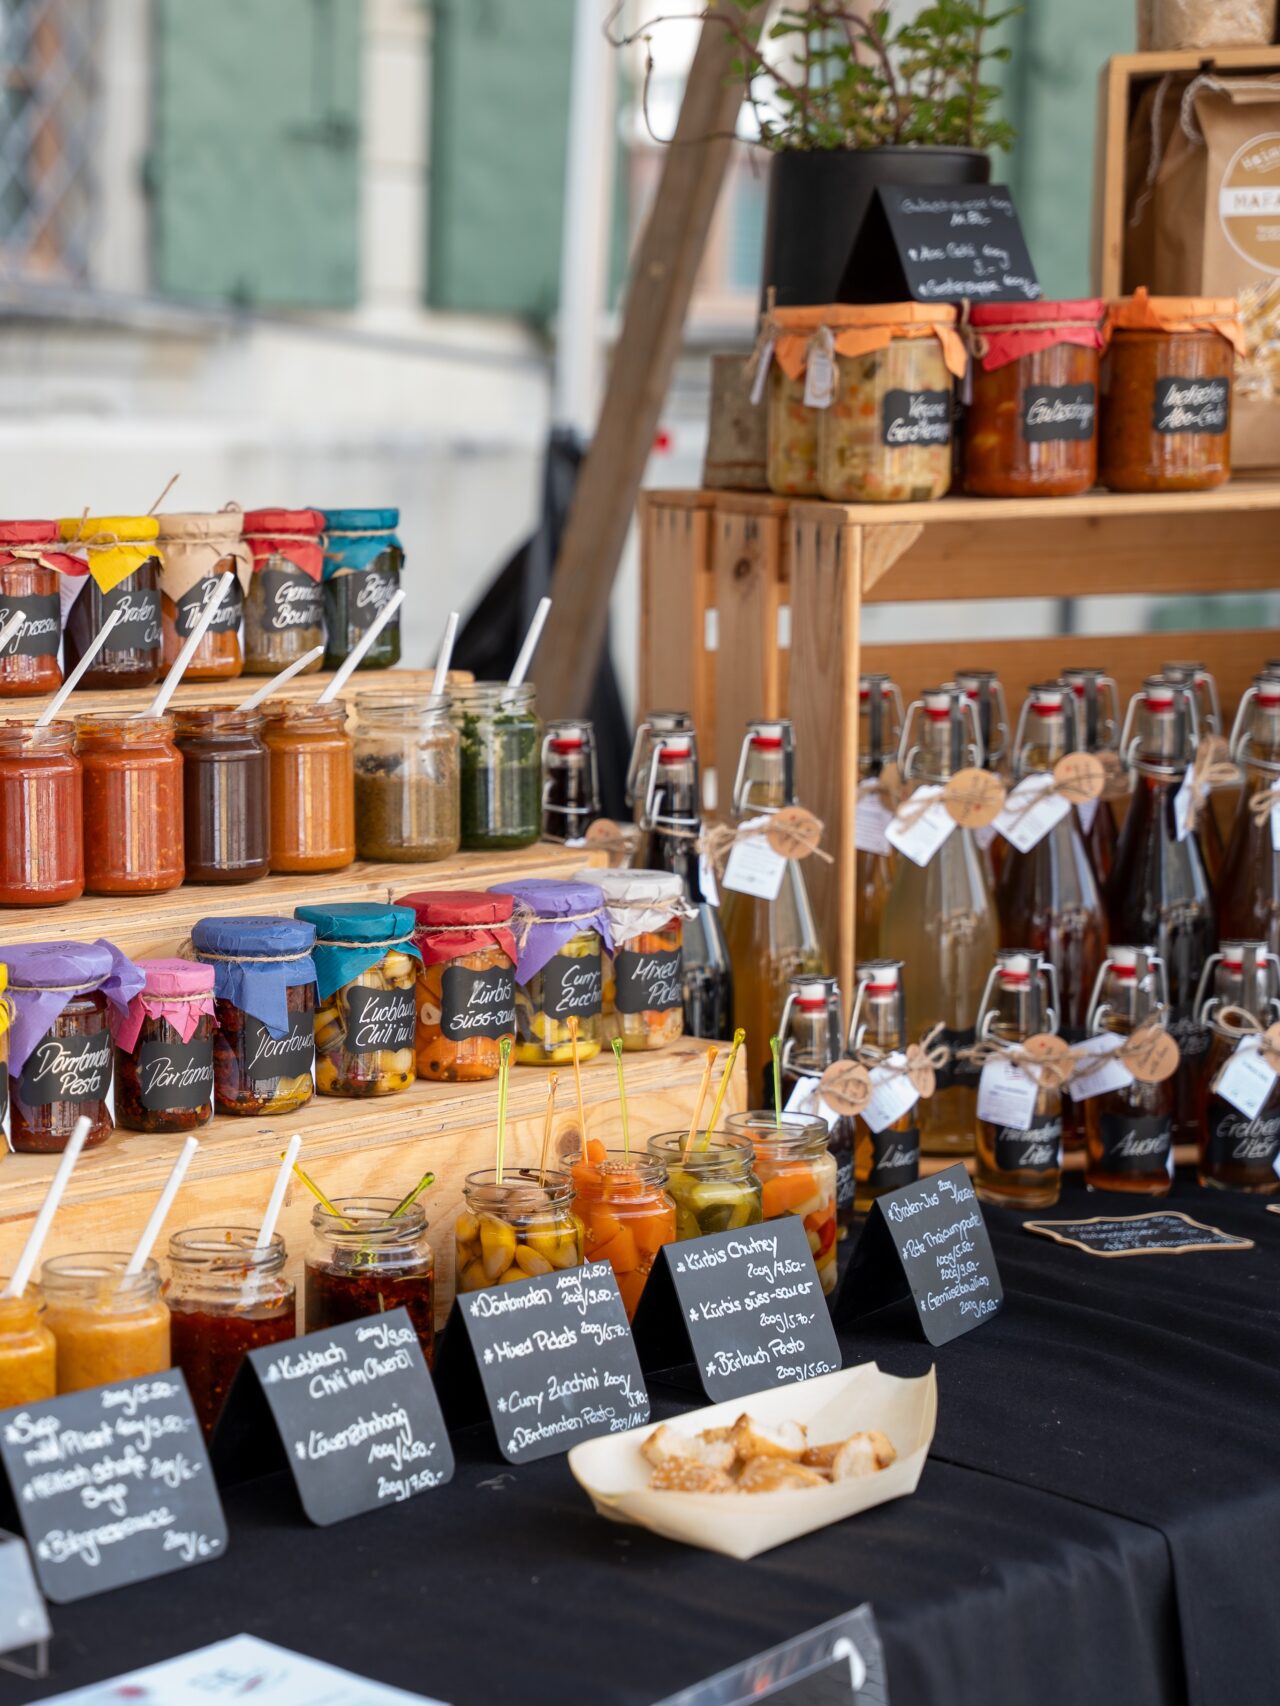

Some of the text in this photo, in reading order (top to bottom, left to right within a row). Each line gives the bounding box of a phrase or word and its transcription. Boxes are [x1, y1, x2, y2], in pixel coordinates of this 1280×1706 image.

[631, 957, 680, 981] Mixed
[466, 977, 513, 1008] Kürbis
[355, 1023, 394, 1048] Chili
[59, 1068, 102, 1096] Pesto
[684, 1235, 778, 1271] Kürbis Chutney
[699, 1296, 742, 1320] Kürbis
[494, 1339, 535, 1363] Mixed
[714, 1336, 806, 1376] Bärlauch Pesto
[508, 1390, 545, 1414] Curry
[546, 1368, 600, 1402] Zucchini
